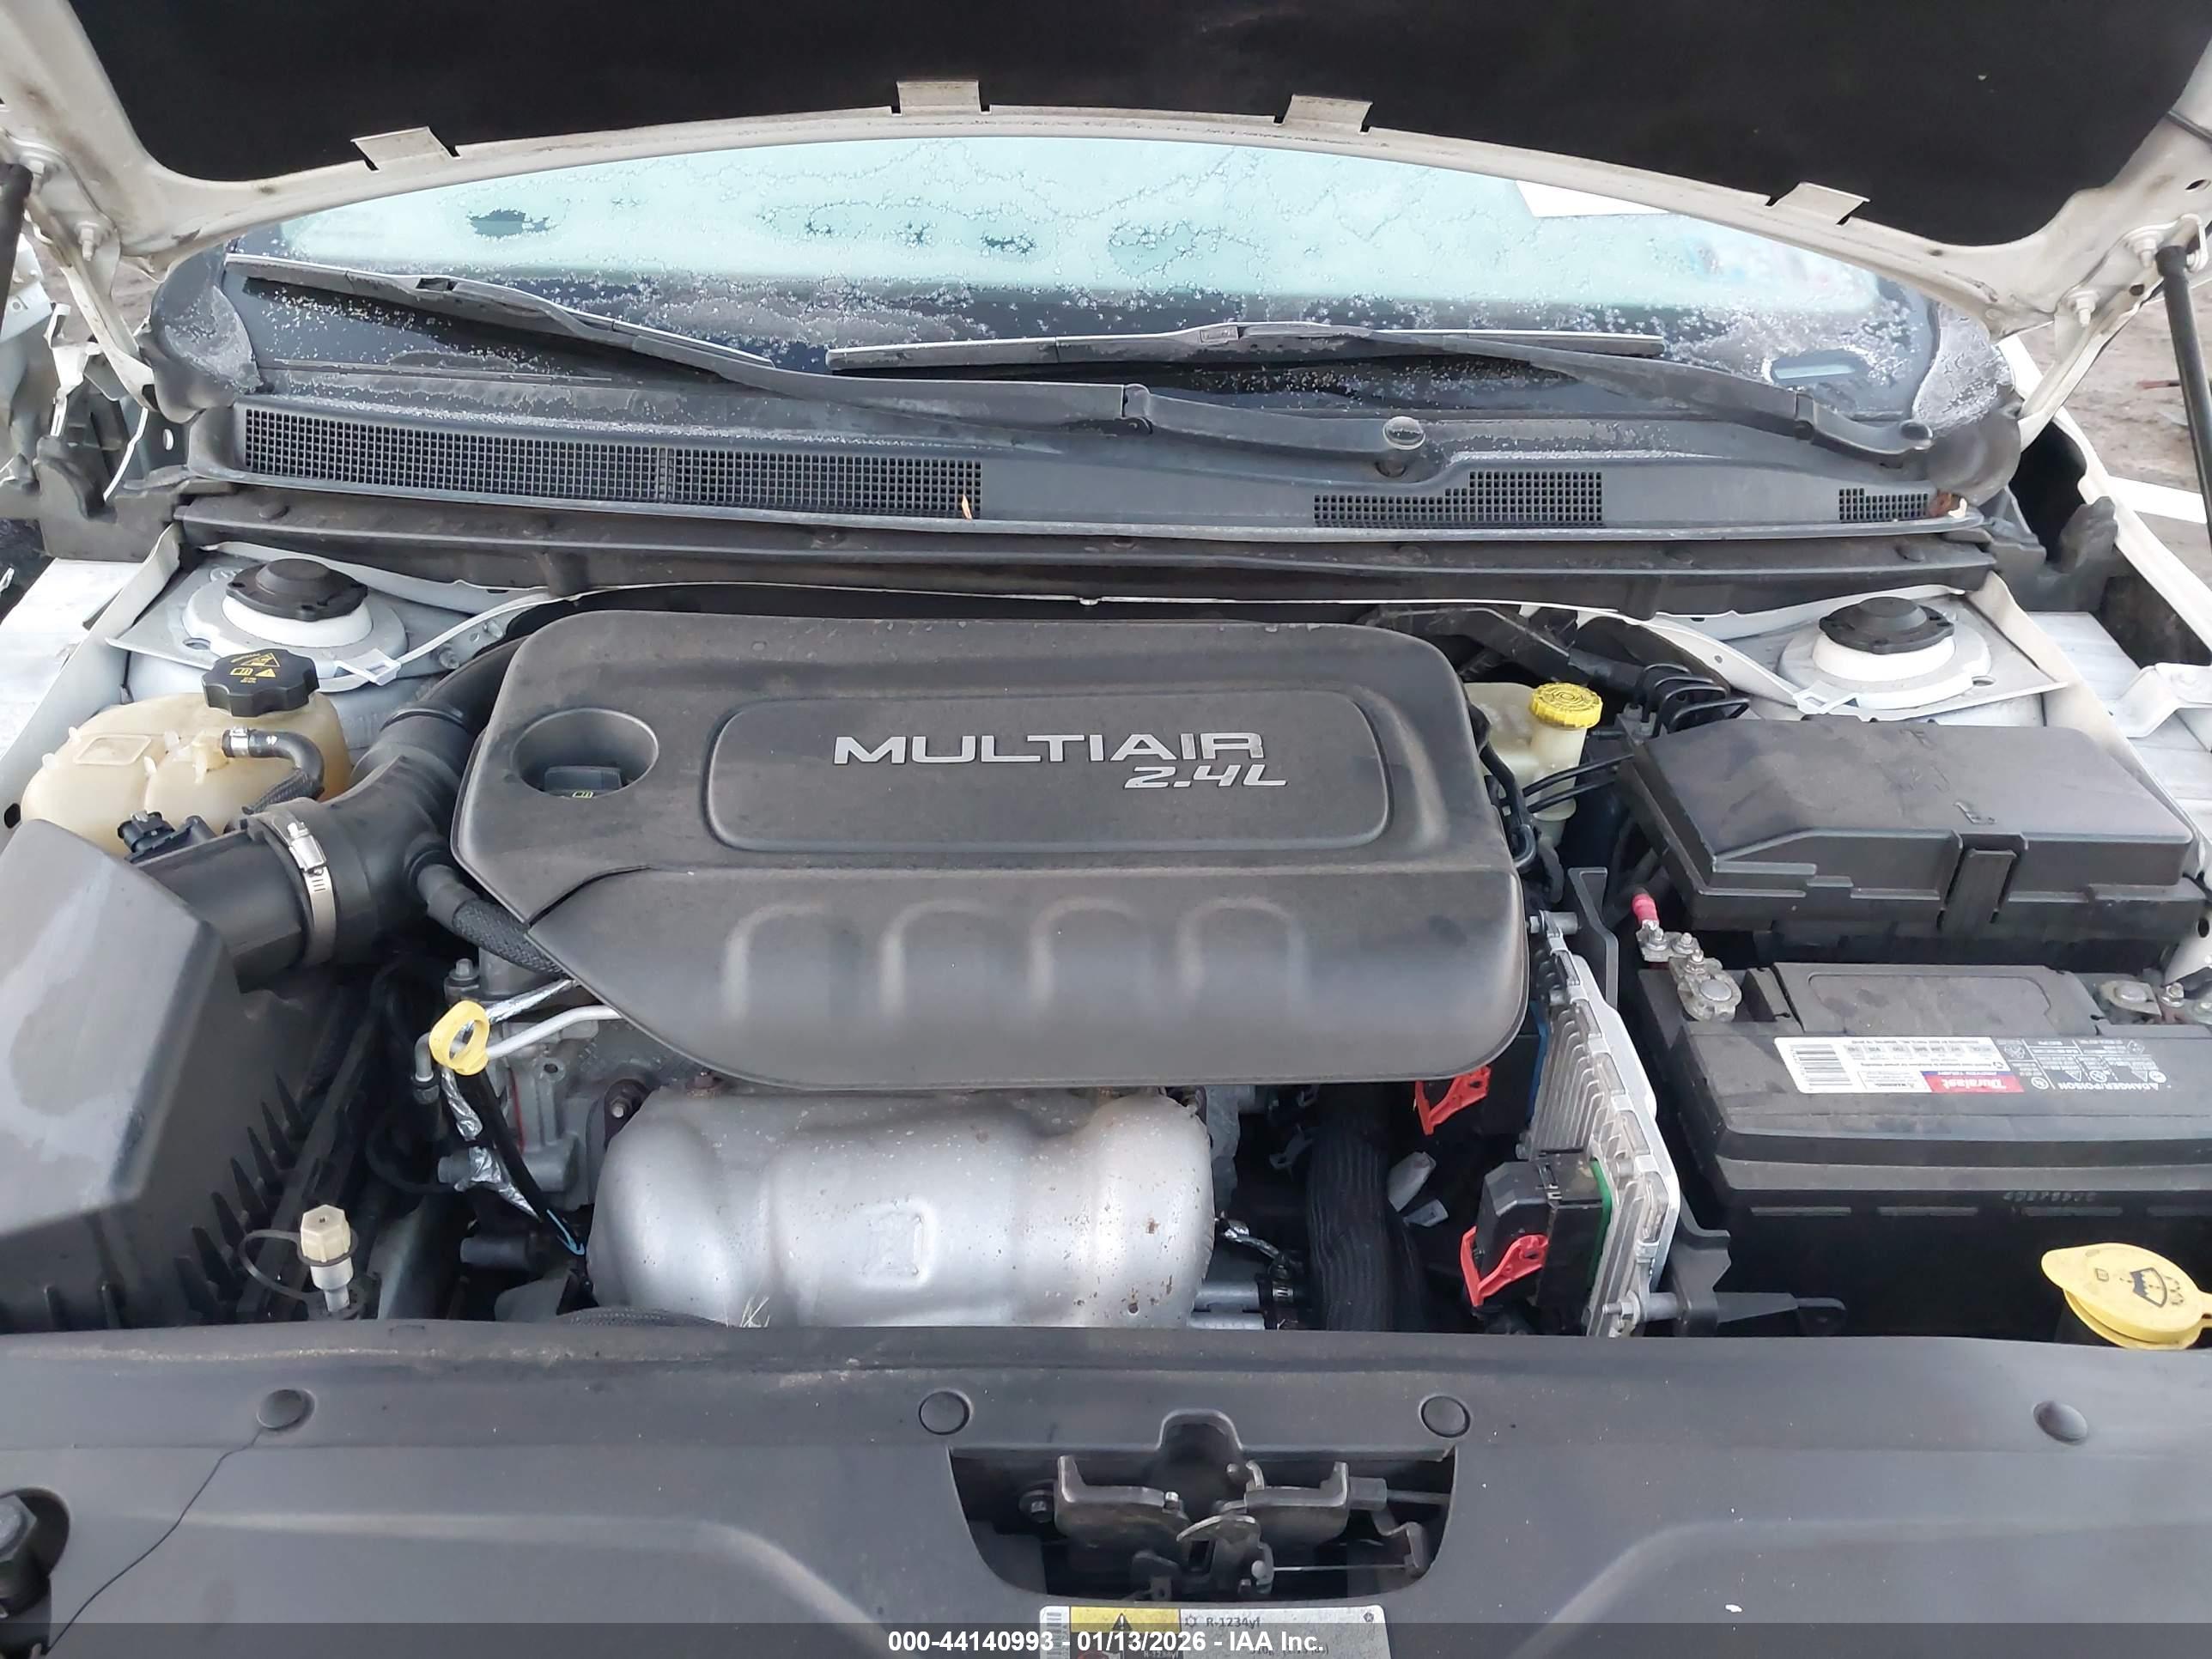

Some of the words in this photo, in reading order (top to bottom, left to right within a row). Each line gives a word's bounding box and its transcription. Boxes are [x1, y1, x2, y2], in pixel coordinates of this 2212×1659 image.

[833, 732, 1264, 764] MULTIAIR
[1124, 763, 1287, 789] 2.4L
[1941, 1078, 2007, 1089] Duralast
[1206, 1616, 1261, 1629] R-1234yf
